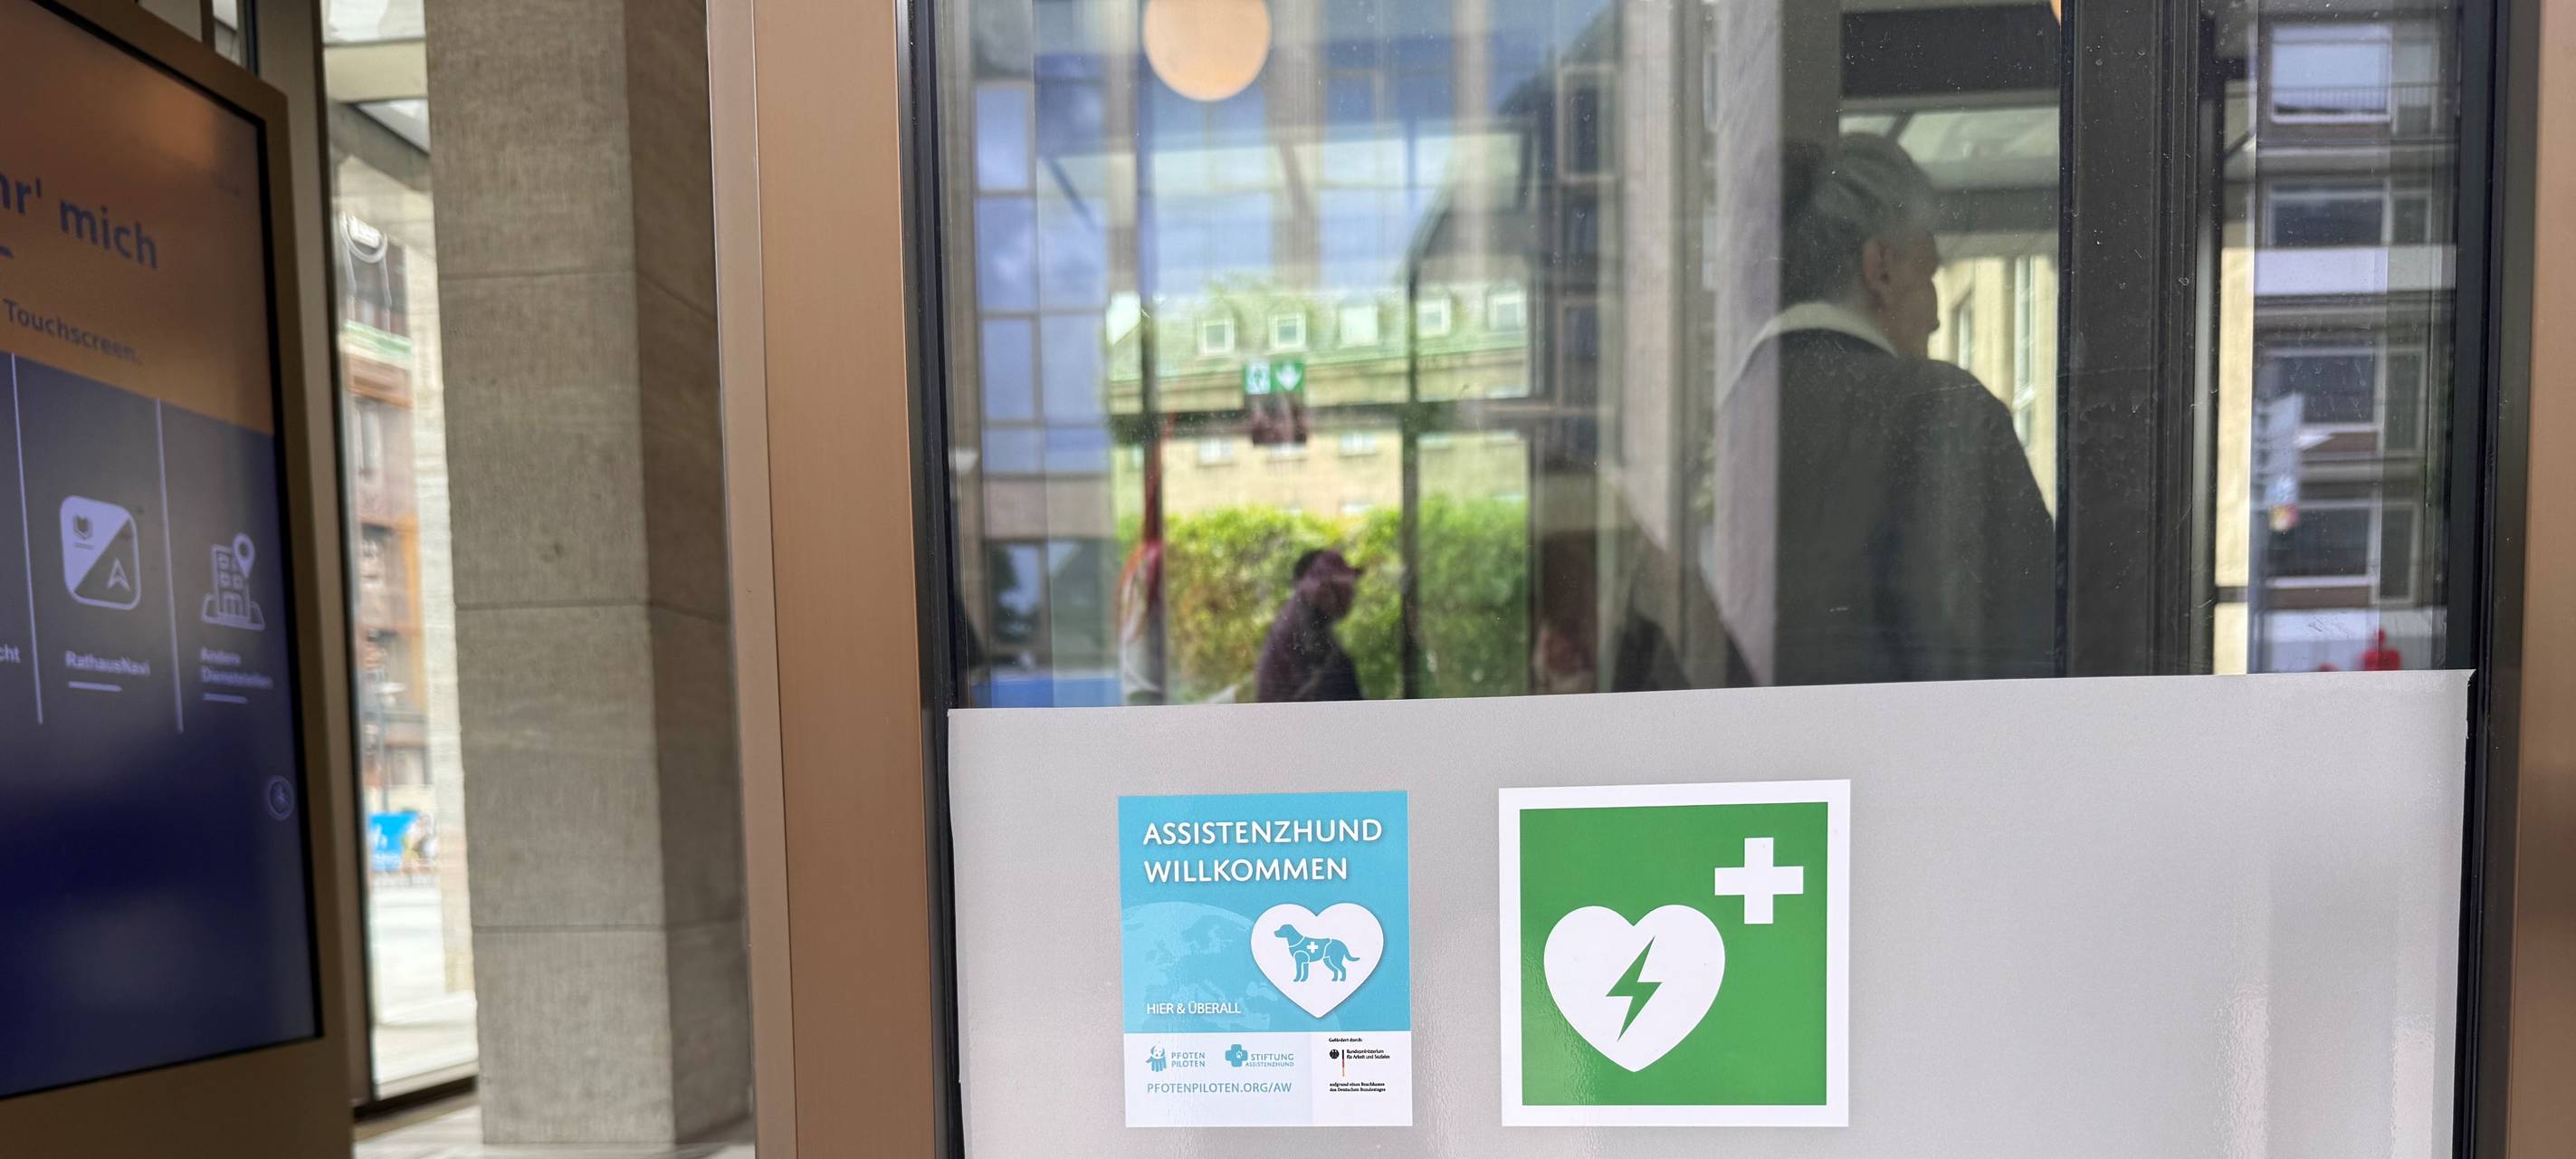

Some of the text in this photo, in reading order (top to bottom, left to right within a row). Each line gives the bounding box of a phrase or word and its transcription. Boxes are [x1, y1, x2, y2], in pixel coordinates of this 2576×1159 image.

[60, 199, 157, 270] mich
[65, 650, 150, 675] RathausNavi
[1143, 819, 1382, 846] ASSISTENZHUND
[1143, 857, 1348, 883] WILLKOMMEN
[1147, 1002, 1174, 1015] HIER
[1177, 1003, 1186, 1014] &
[1171, 1051, 1206, 1059] PFOTEN
[1251, 1053, 1294, 1061] STIFTUNG
[1147, 1082, 1293, 1094] PFOTENPILOTEN.ORG/AW
